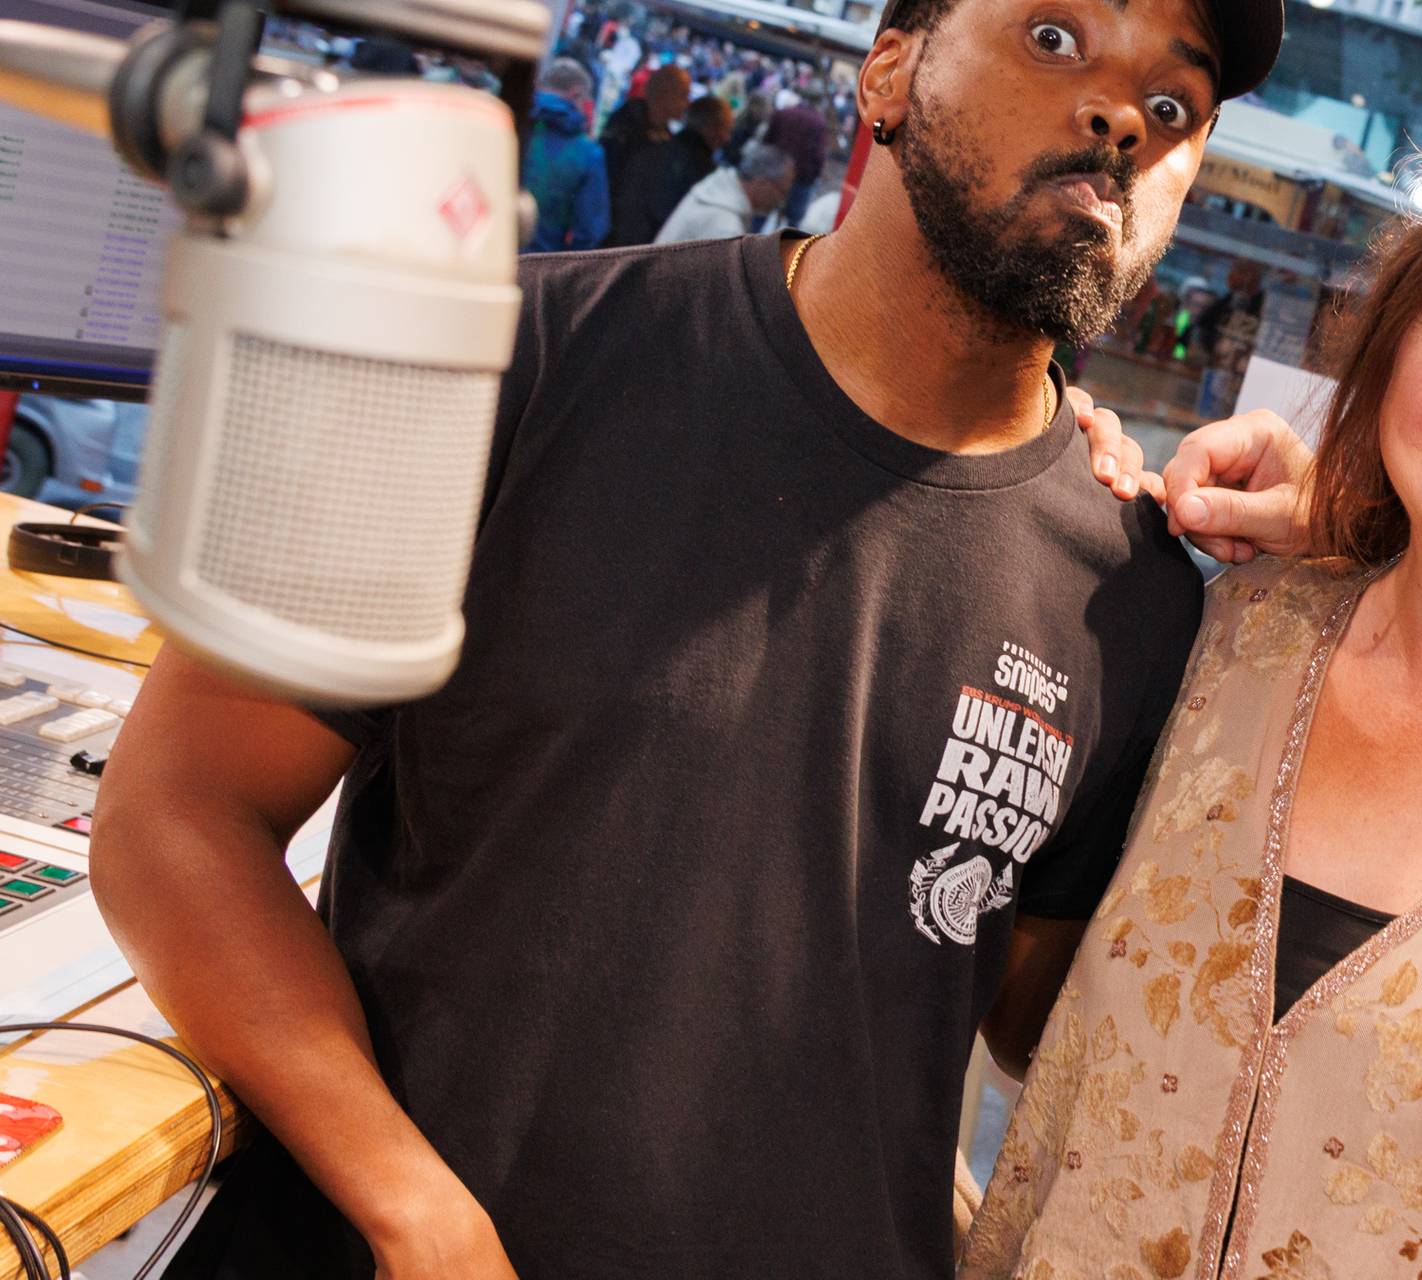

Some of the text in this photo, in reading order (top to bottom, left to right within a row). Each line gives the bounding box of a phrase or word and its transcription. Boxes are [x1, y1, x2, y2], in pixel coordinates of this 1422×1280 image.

[993, 654, 1058, 714] snipes
[936, 737, 1061, 825] RAW
[952, 694, 1073, 786] UNLEASH
